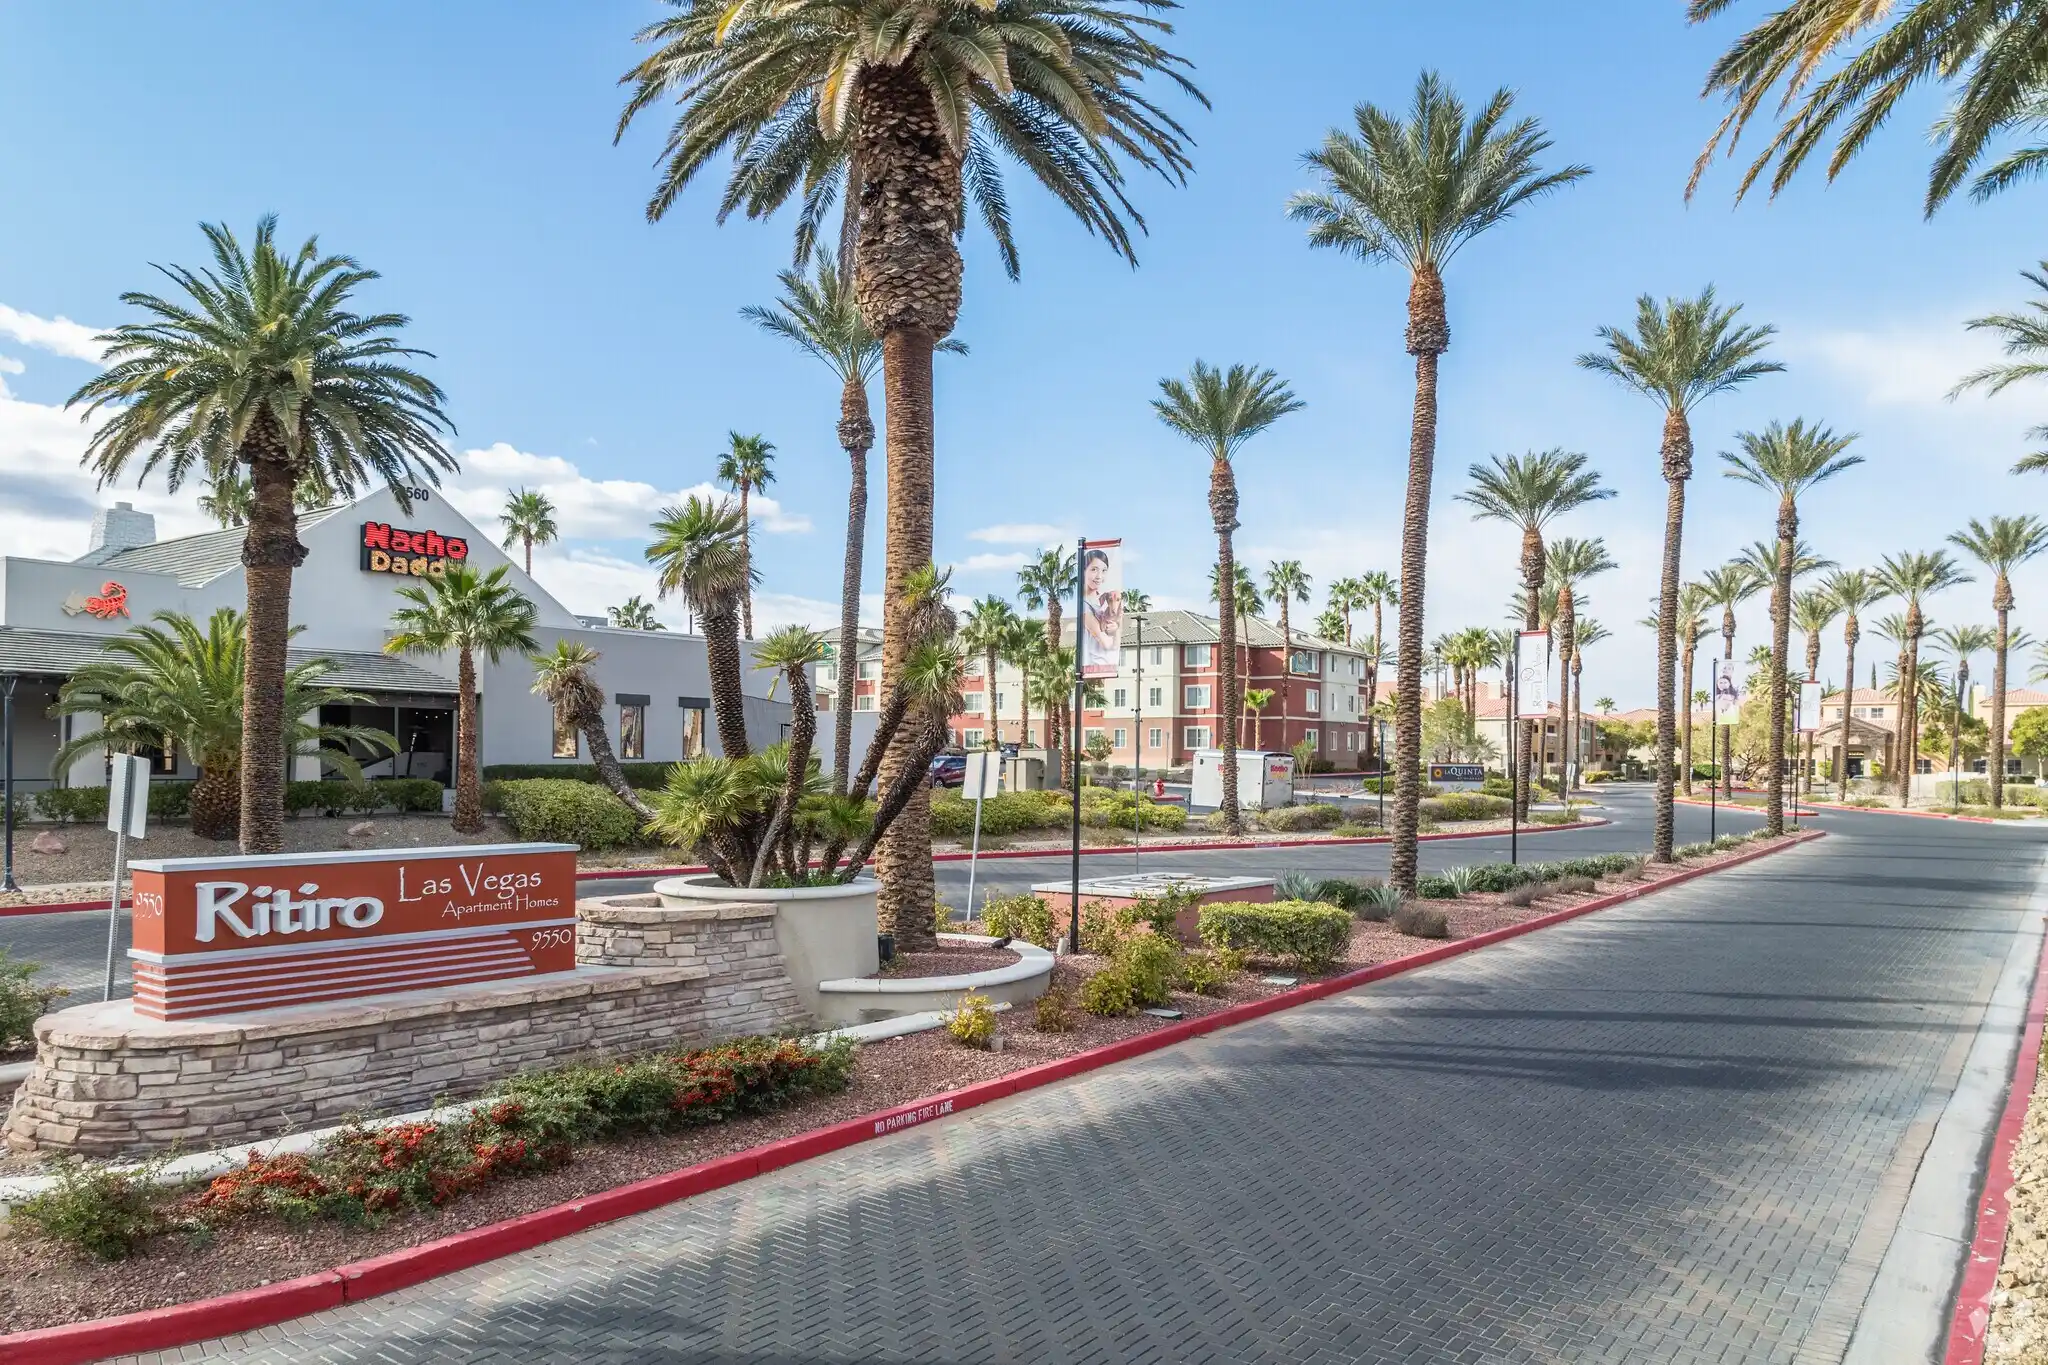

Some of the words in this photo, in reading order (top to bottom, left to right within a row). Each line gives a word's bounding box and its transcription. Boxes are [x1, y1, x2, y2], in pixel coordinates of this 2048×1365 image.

[399, 486, 429, 501] 560
[364, 521, 468, 559] Nacho
[370, 550, 457, 579] Dadd
[1450, 766, 1483, 777] QUINTA
[398, 866, 452, 902] Las
[459, 862, 542, 899] Vegas
[135, 892, 163, 920] 9550
[194, 881, 385, 943] Ritiro
[441, 900, 513, 920] Apartment
[515, 894, 559, 911] Homes
[531, 929, 572, 950] 9550
[874, 1120, 885, 1134] NO
[886, 1111, 917, 1131] PARKING
[918, 1105, 934, 1121] FIRE
[935, 1100, 953, 1116] LANE
